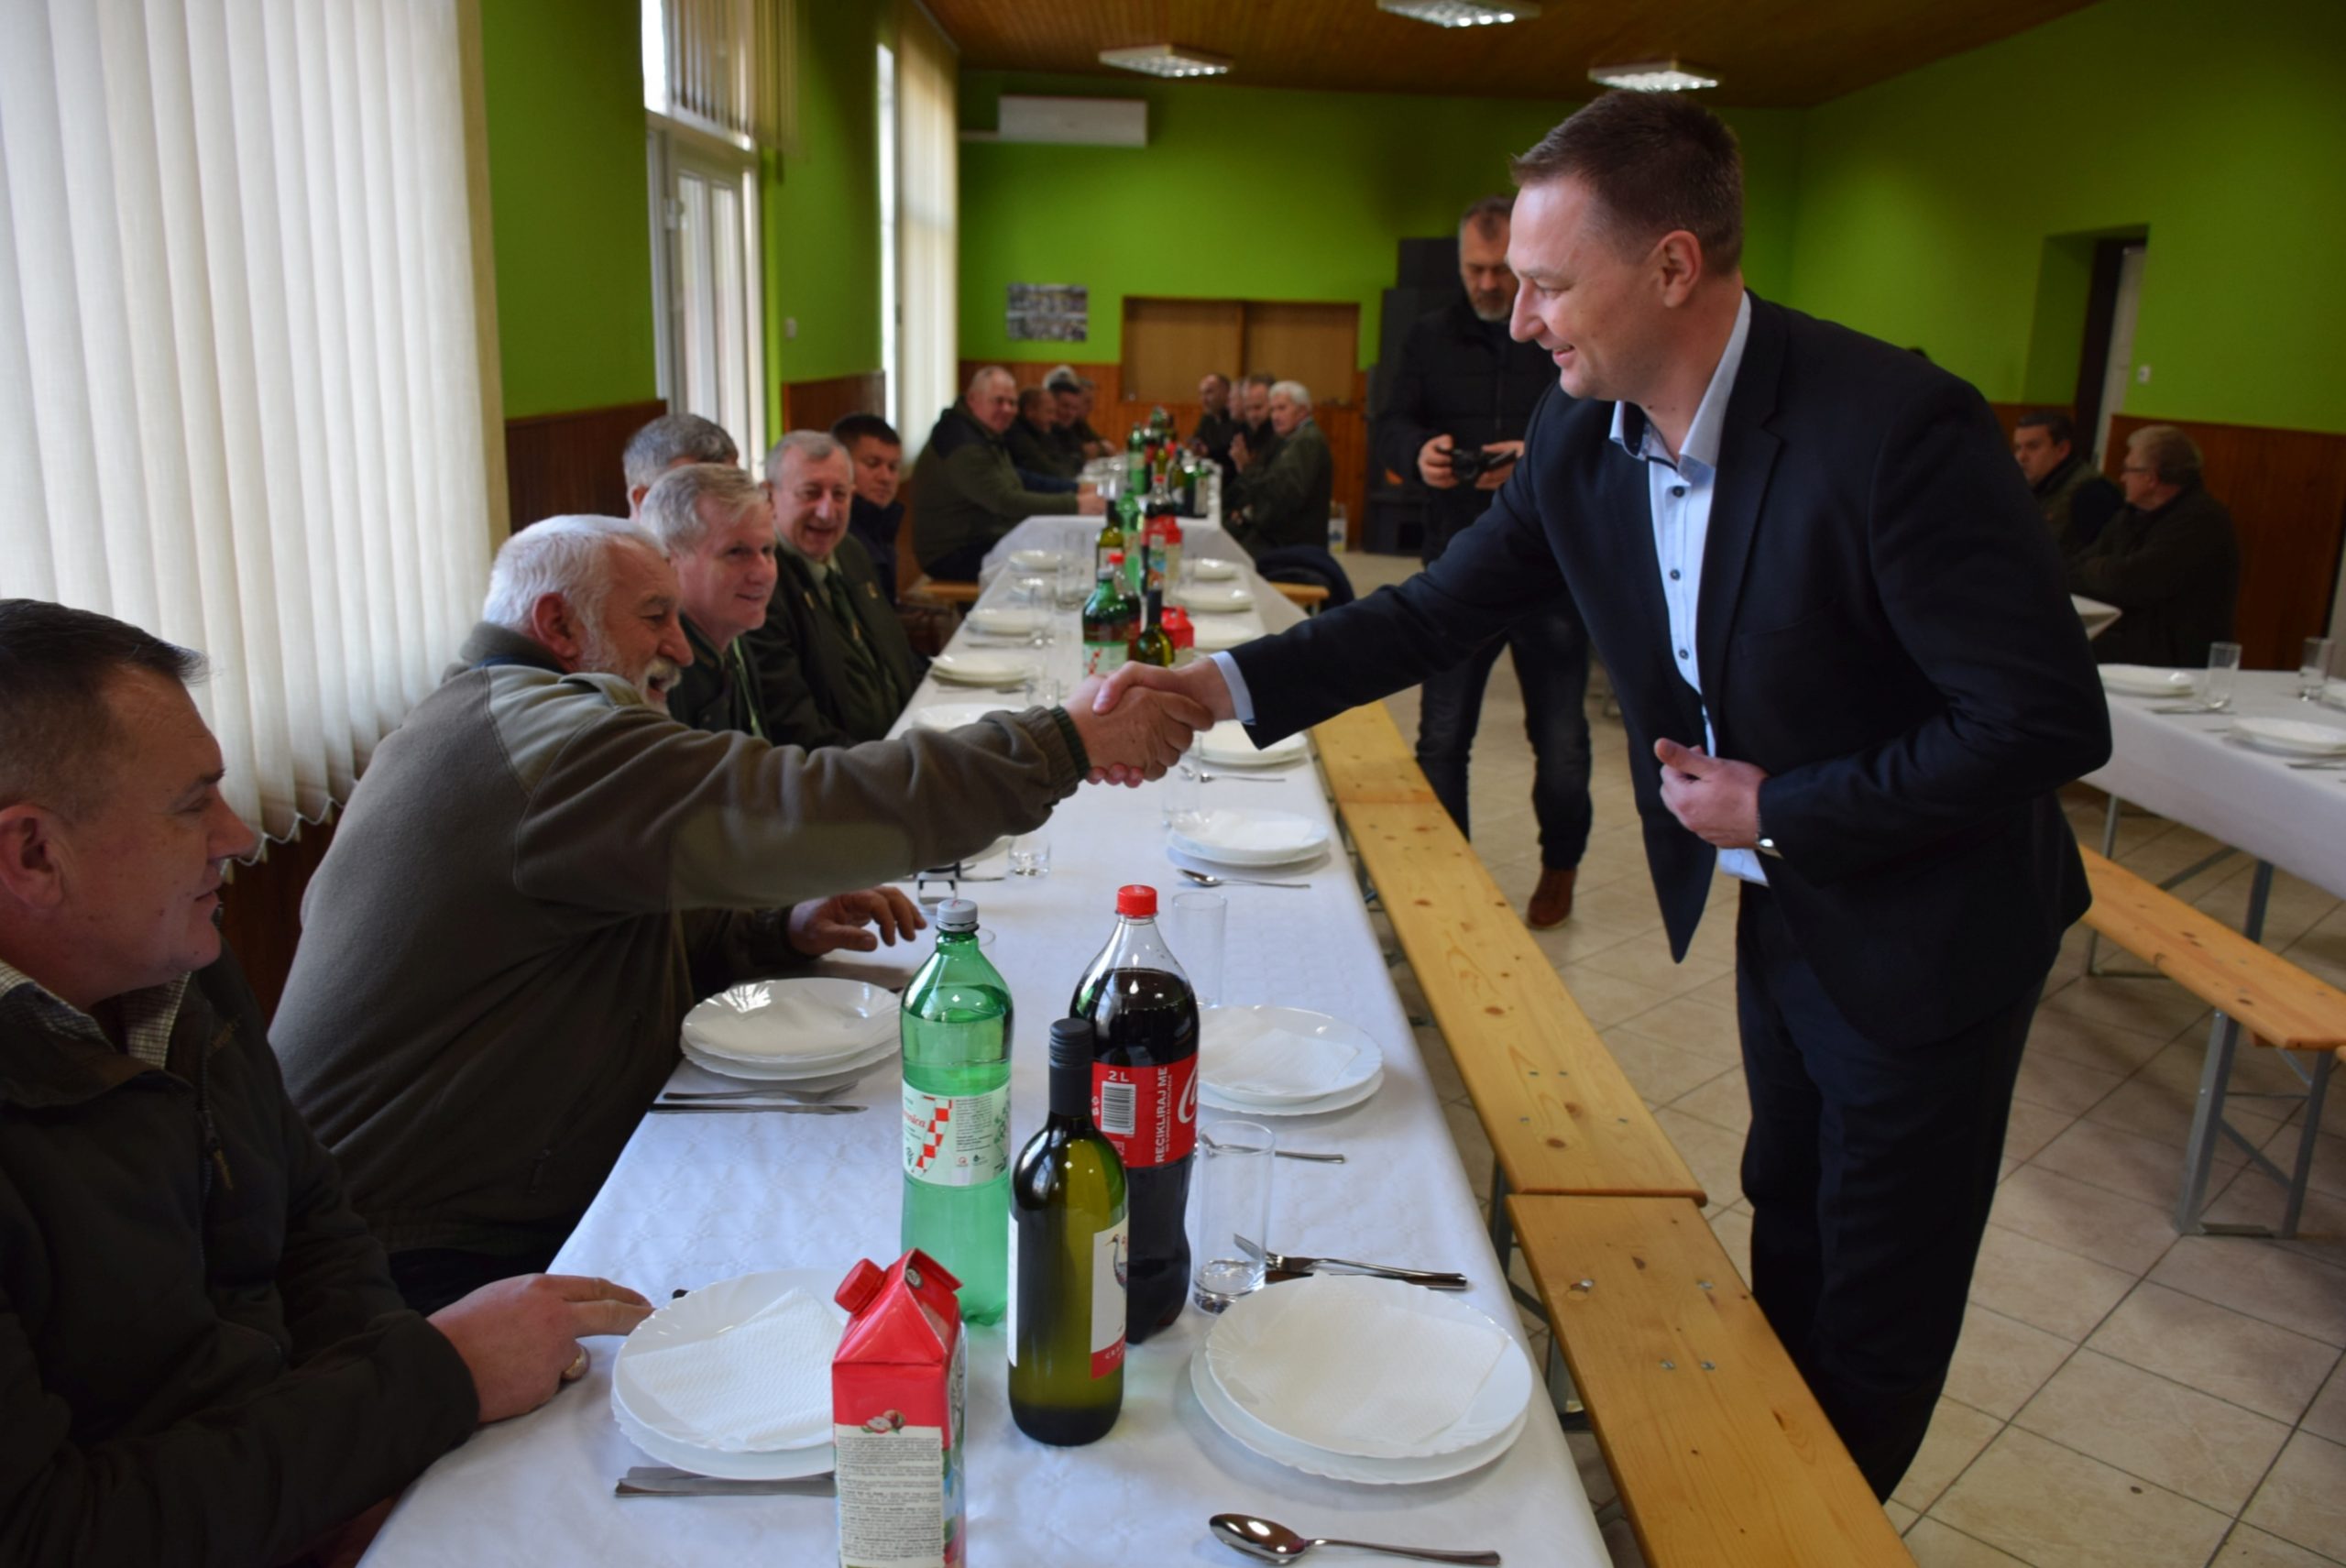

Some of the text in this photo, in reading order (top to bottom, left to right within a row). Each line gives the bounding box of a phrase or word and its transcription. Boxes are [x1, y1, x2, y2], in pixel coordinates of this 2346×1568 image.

[1108, 1070, 1129, 1082] 2 L
[1155, 1067, 1168, 1163] RECIKLIRAJ ME
